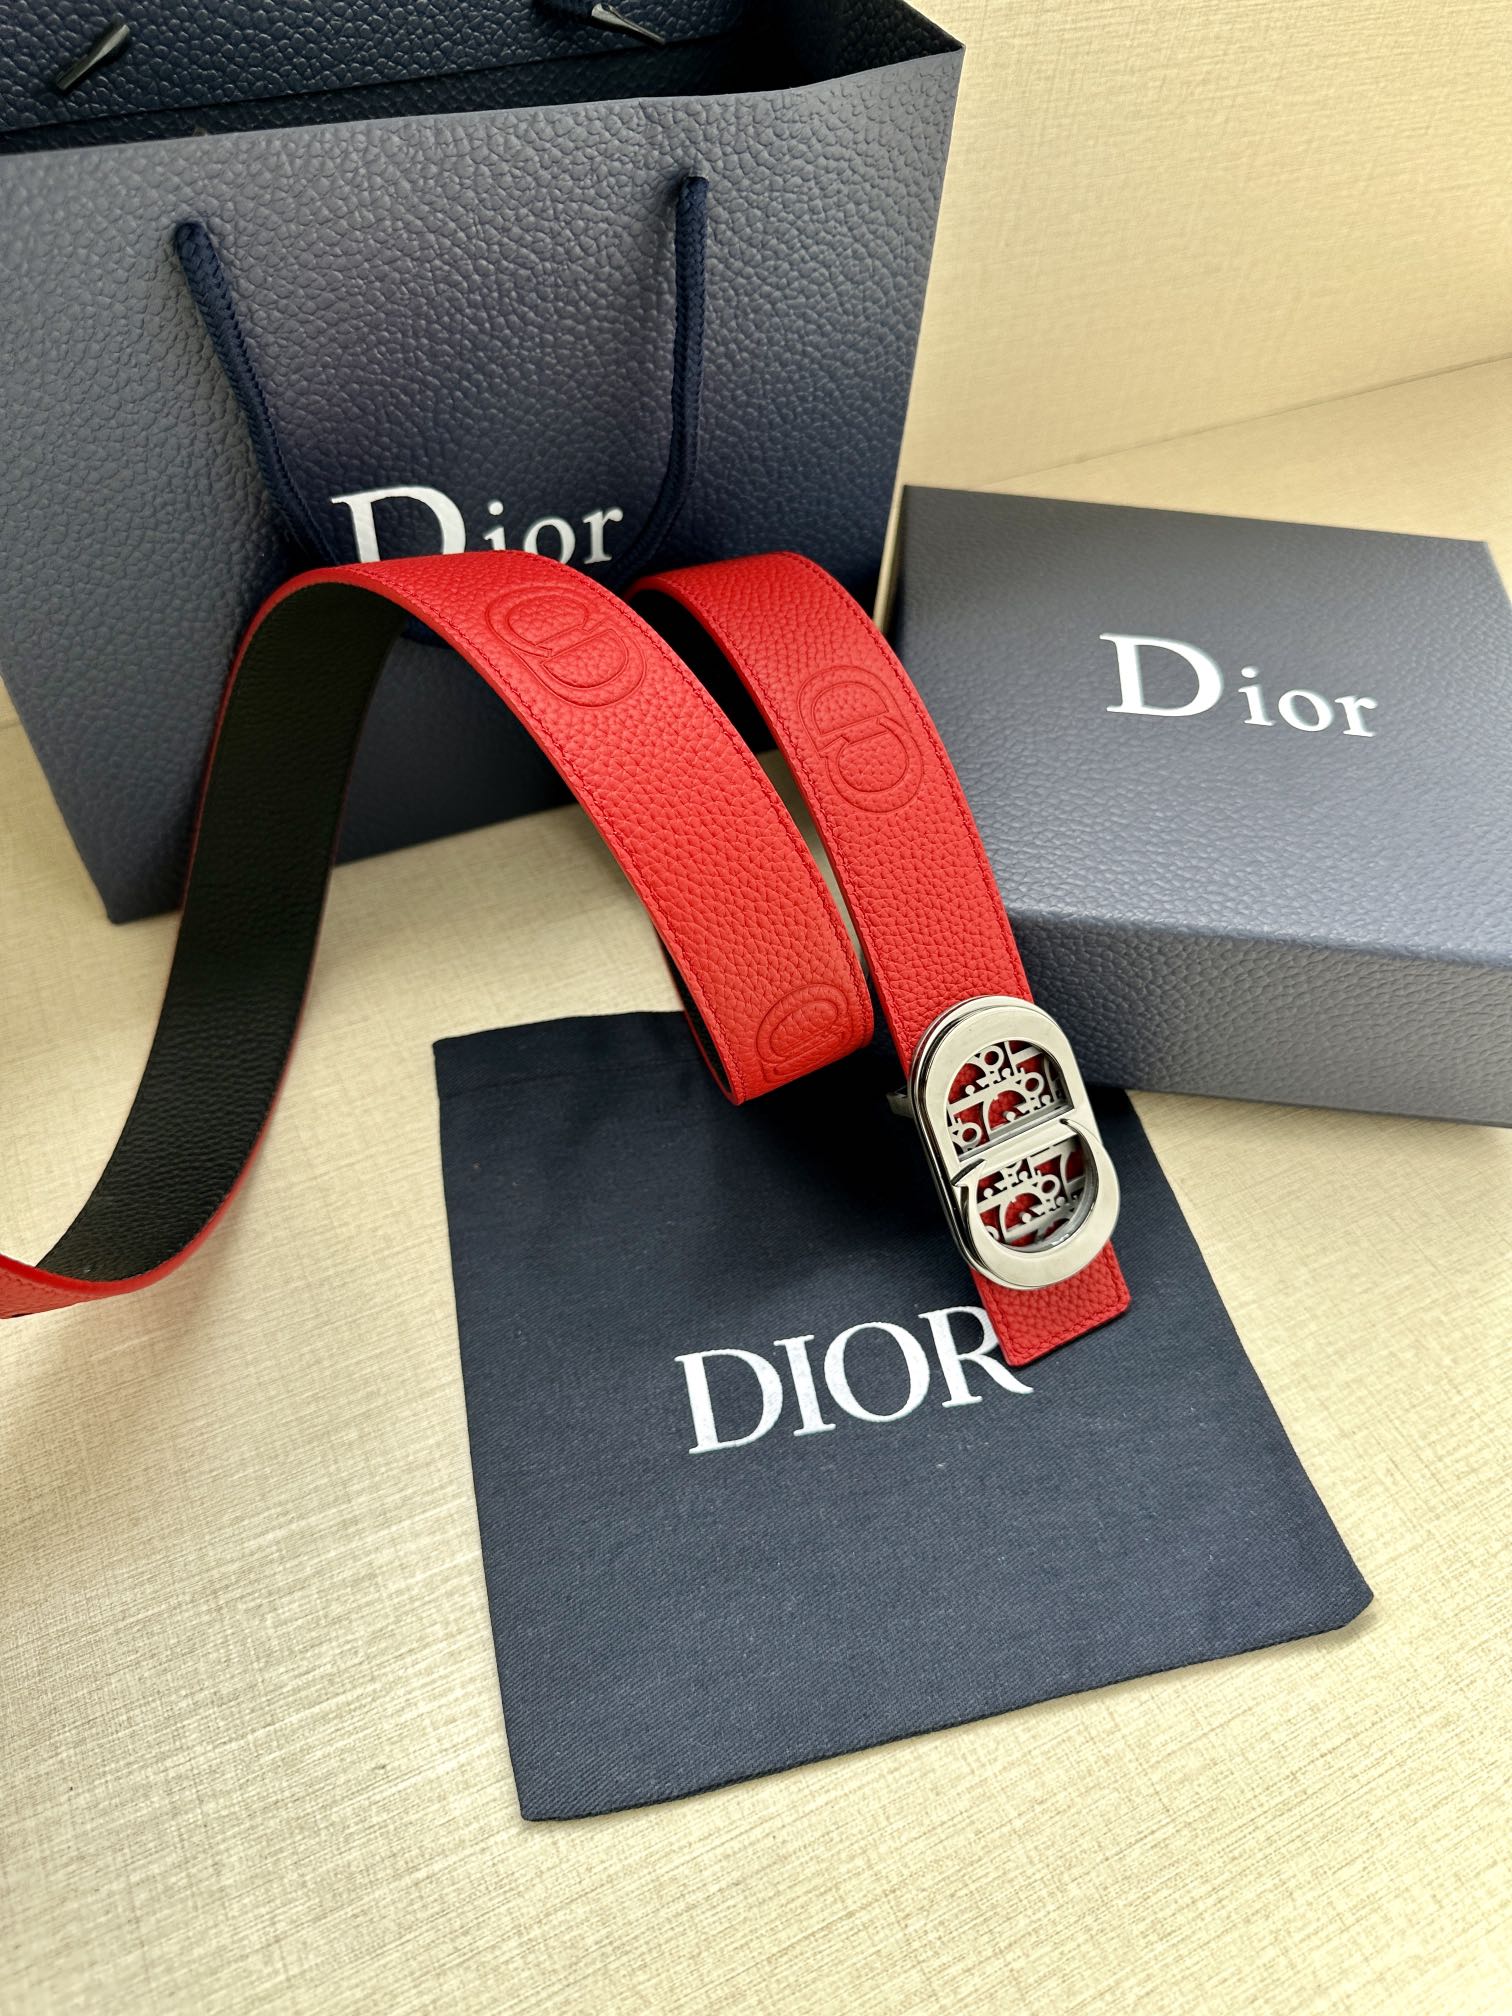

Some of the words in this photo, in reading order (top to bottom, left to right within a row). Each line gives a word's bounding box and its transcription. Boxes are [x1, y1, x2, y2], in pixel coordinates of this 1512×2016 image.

[331, 486, 623, 564] Dior
[1099, 632, 1378, 738] Dior
[674, 1305, 1034, 1454] DIOR
